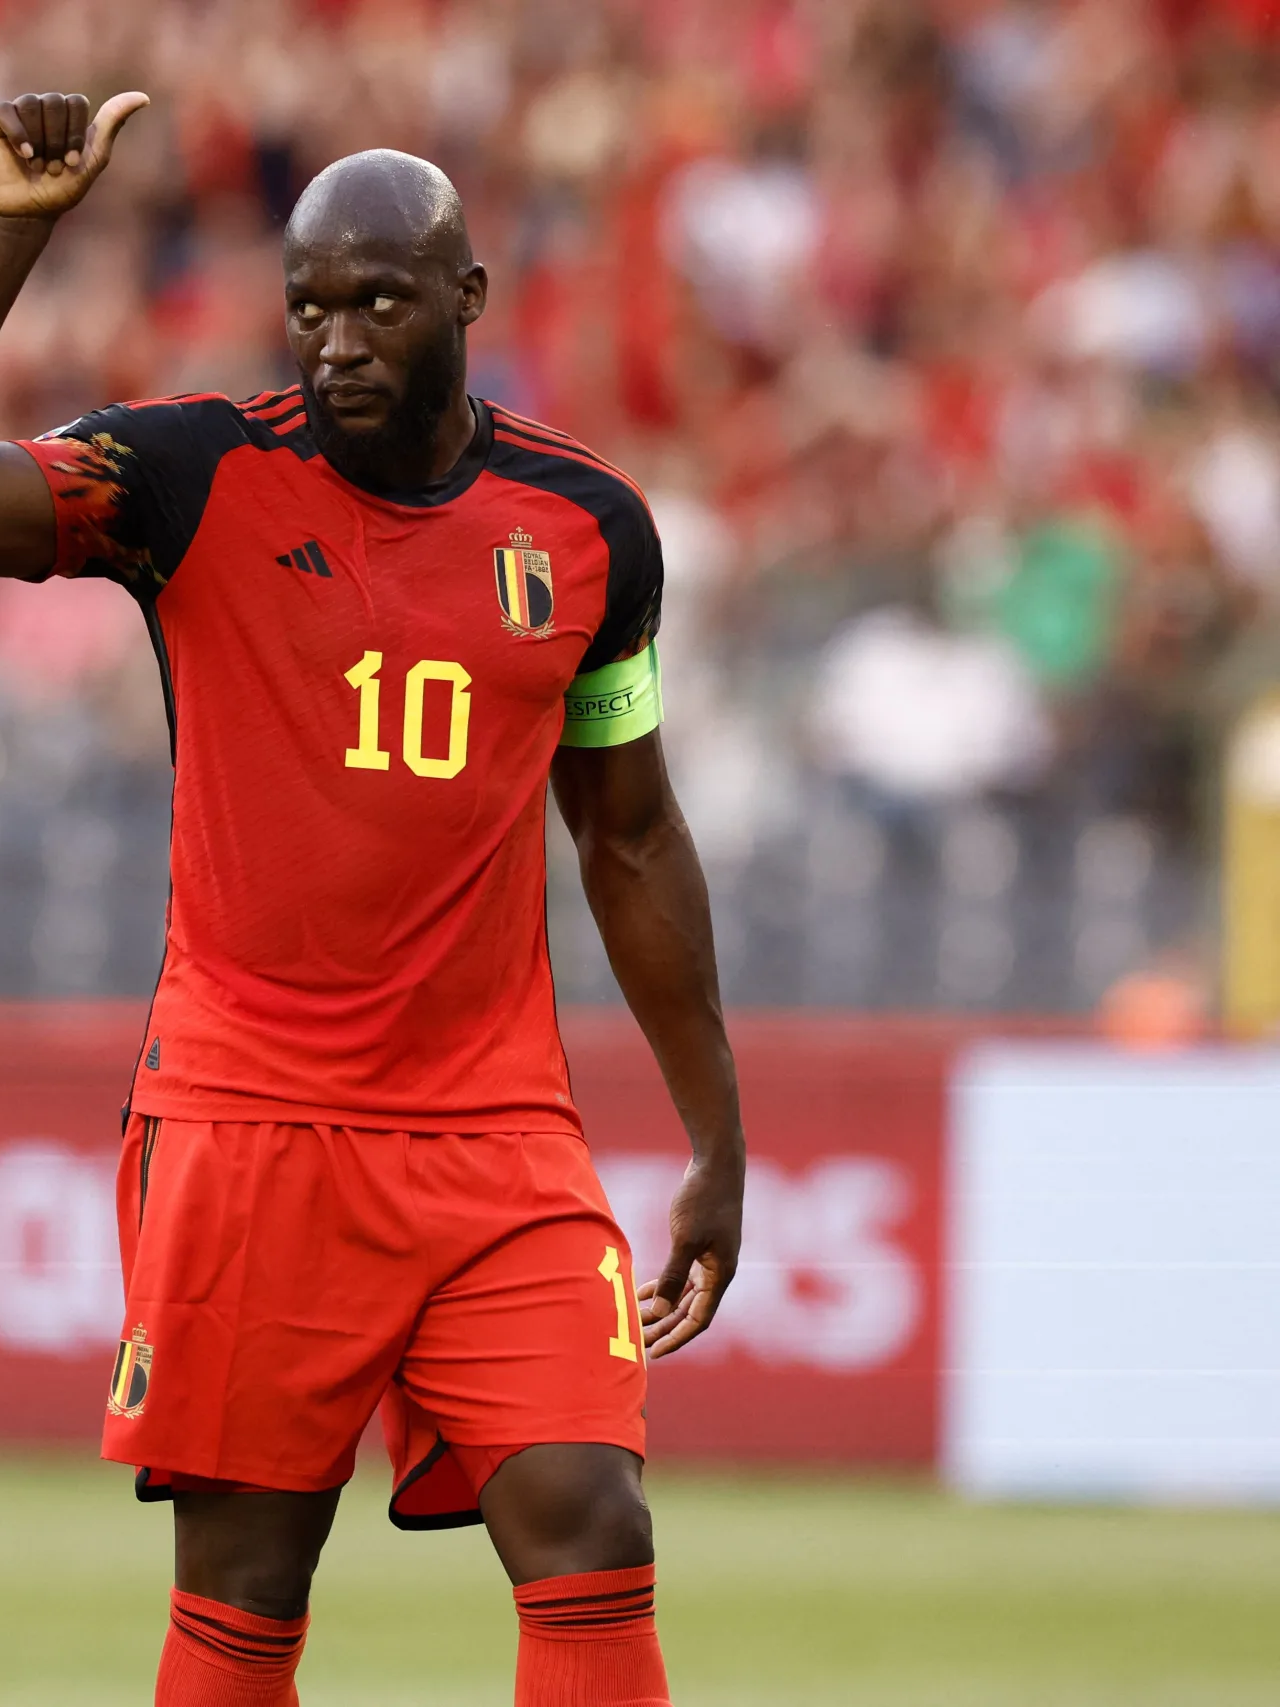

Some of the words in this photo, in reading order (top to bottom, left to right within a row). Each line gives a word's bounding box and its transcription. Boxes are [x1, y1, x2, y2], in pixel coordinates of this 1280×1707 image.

[344, 651, 471, 778] 10
[565, 691, 633, 716] ESPECT
[596, 1244, 648, 1371] 1
